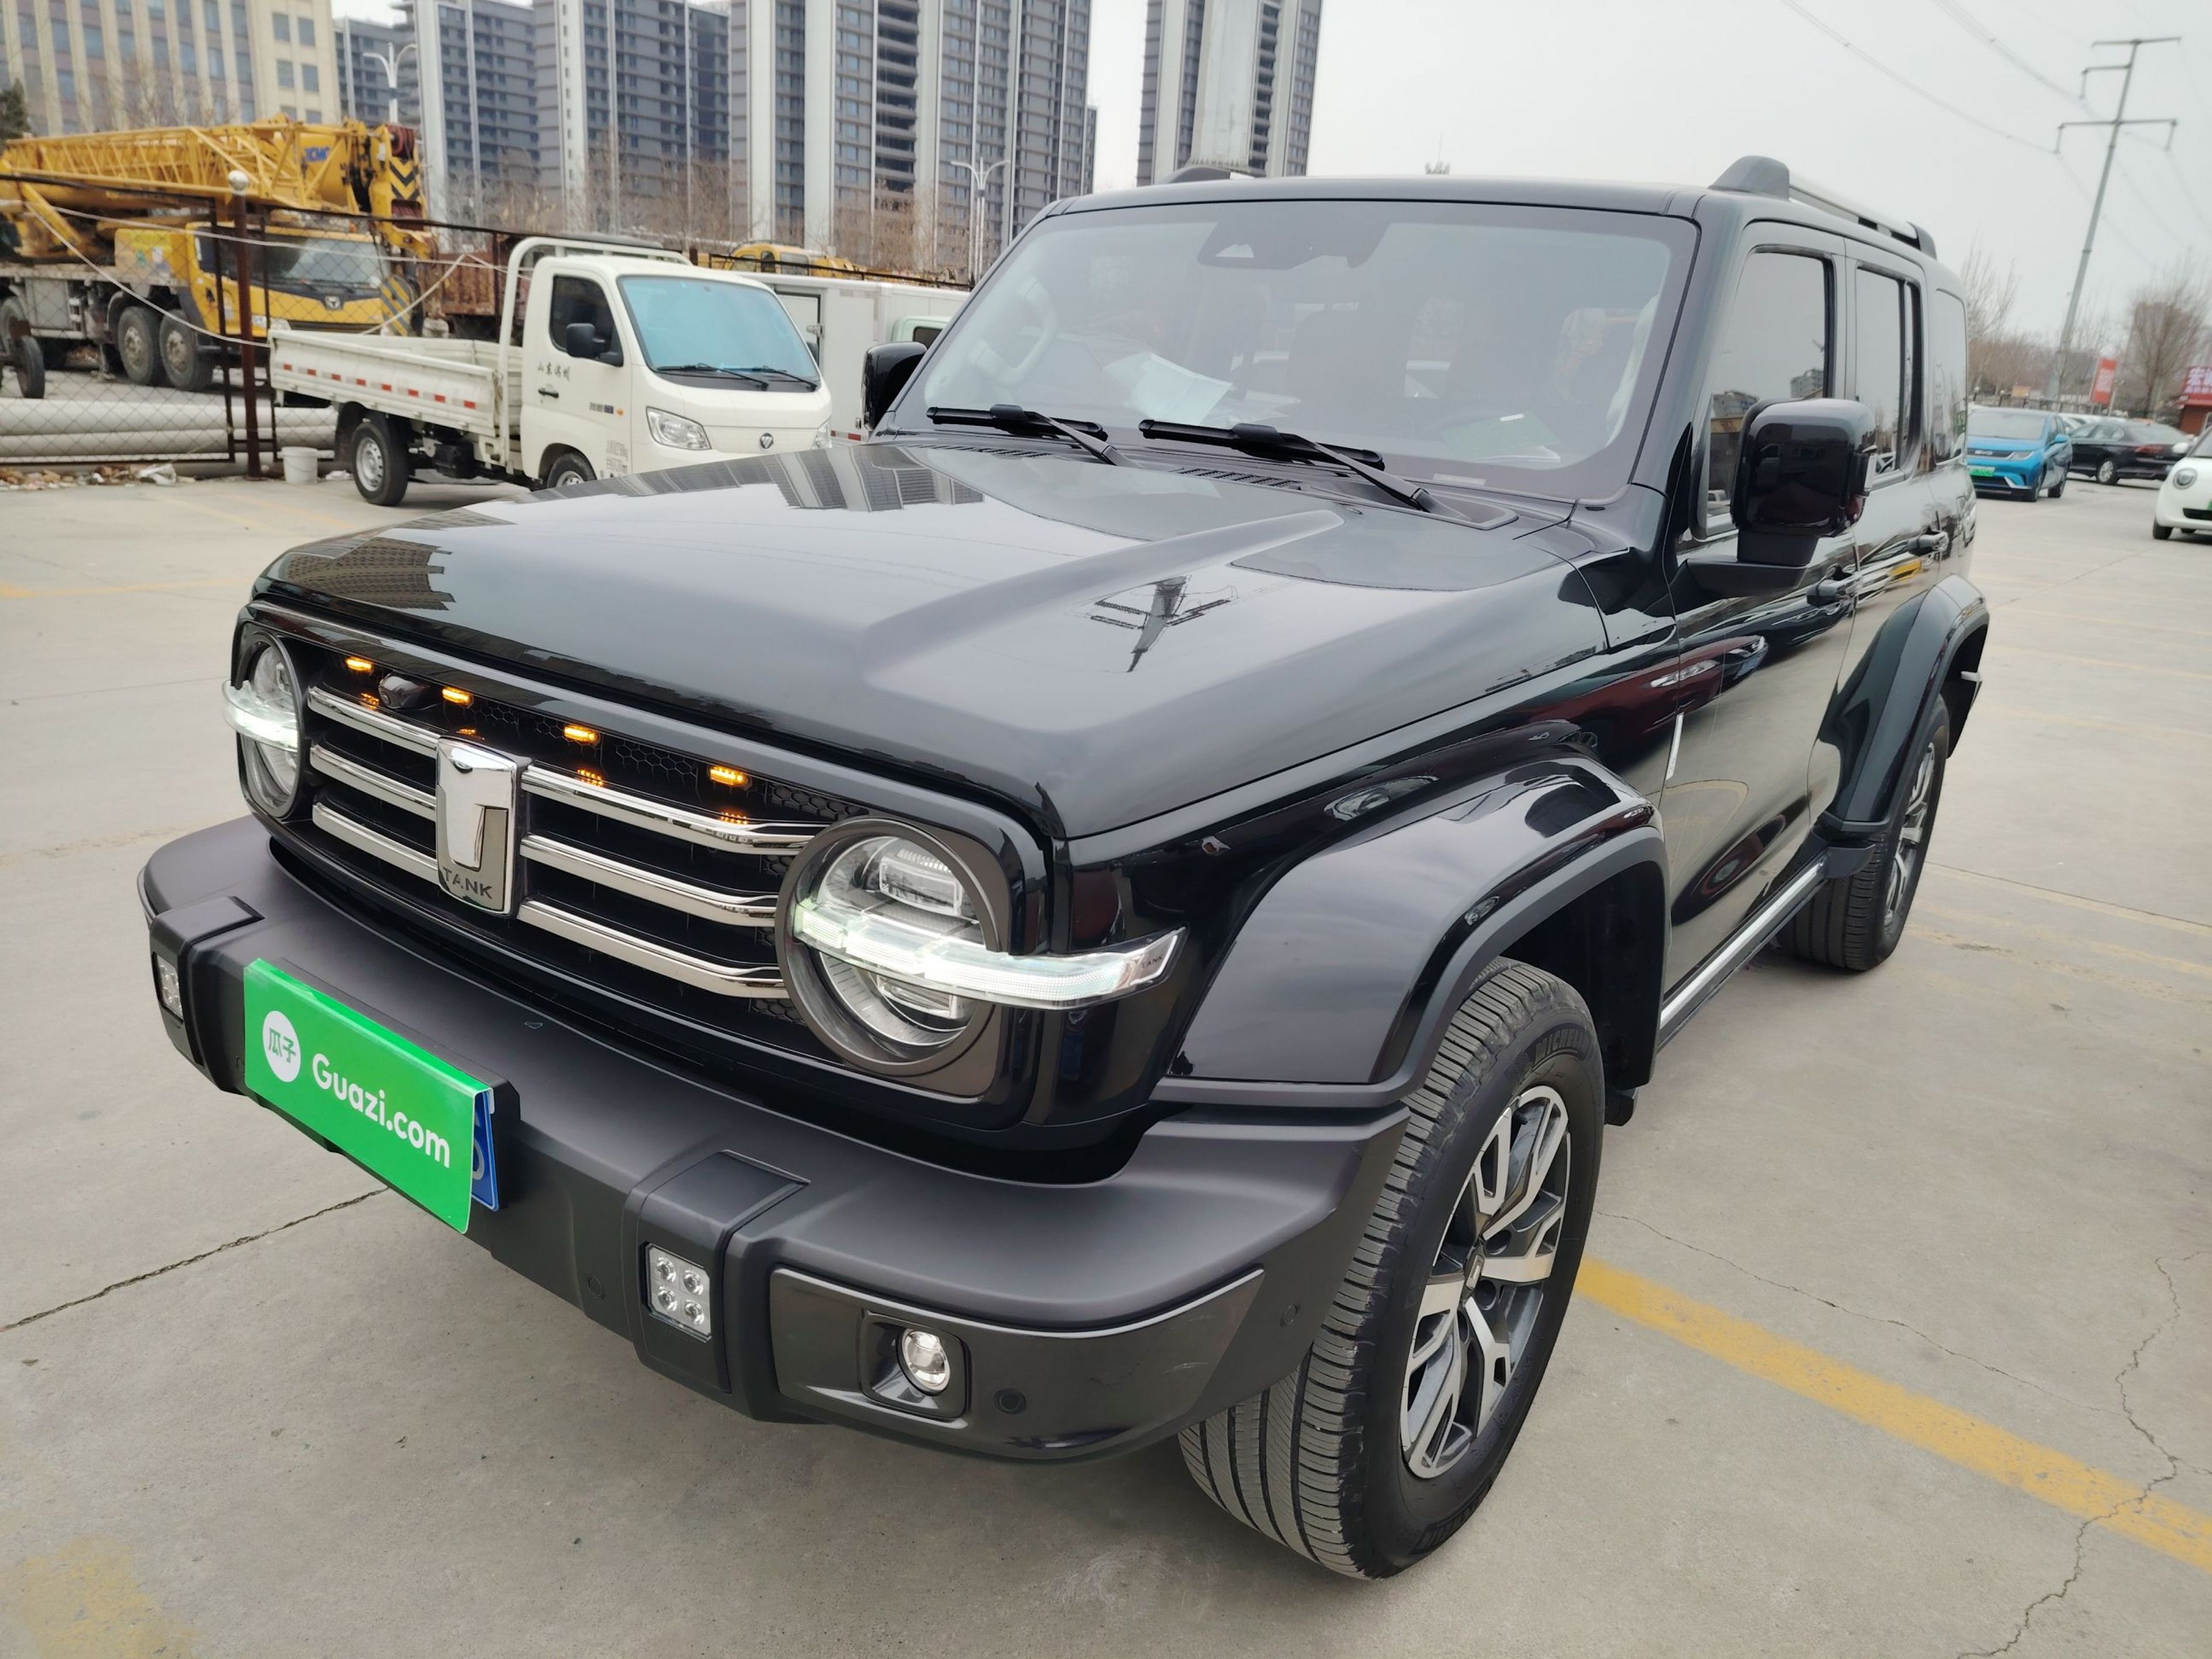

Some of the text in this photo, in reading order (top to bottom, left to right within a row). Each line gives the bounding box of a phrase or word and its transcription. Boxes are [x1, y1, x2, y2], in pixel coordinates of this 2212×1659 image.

[442, 865, 493, 900] TANK
[268, 1027, 297, 1063] 瓜子
[312, 1053, 450, 1168] Guazi.com
